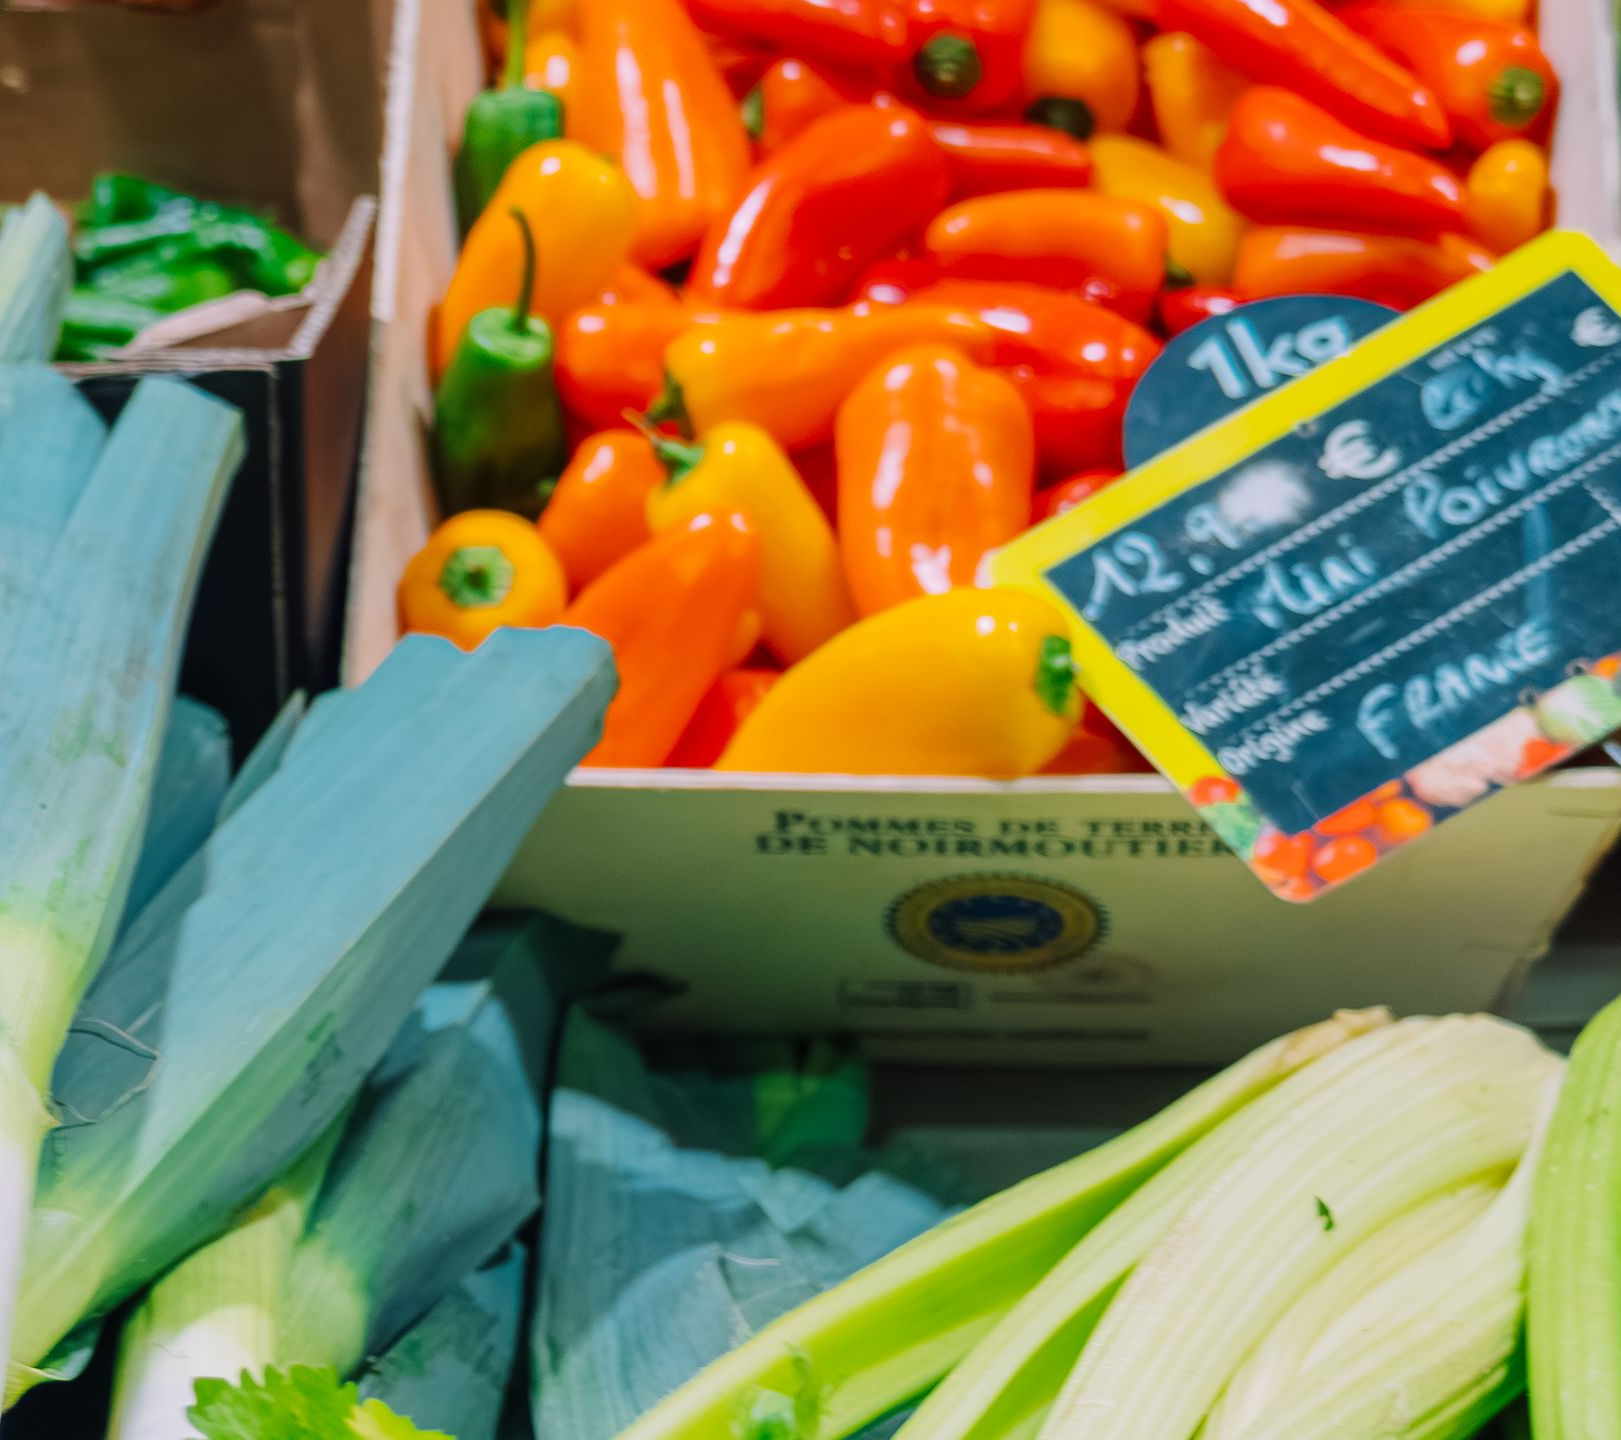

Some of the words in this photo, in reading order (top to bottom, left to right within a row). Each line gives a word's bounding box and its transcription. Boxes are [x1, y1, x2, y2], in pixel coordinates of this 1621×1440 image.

[1217, 707, 1333, 776] Origine
[999, 818, 1060, 837] DE
[755, 833, 829, 857] DE
